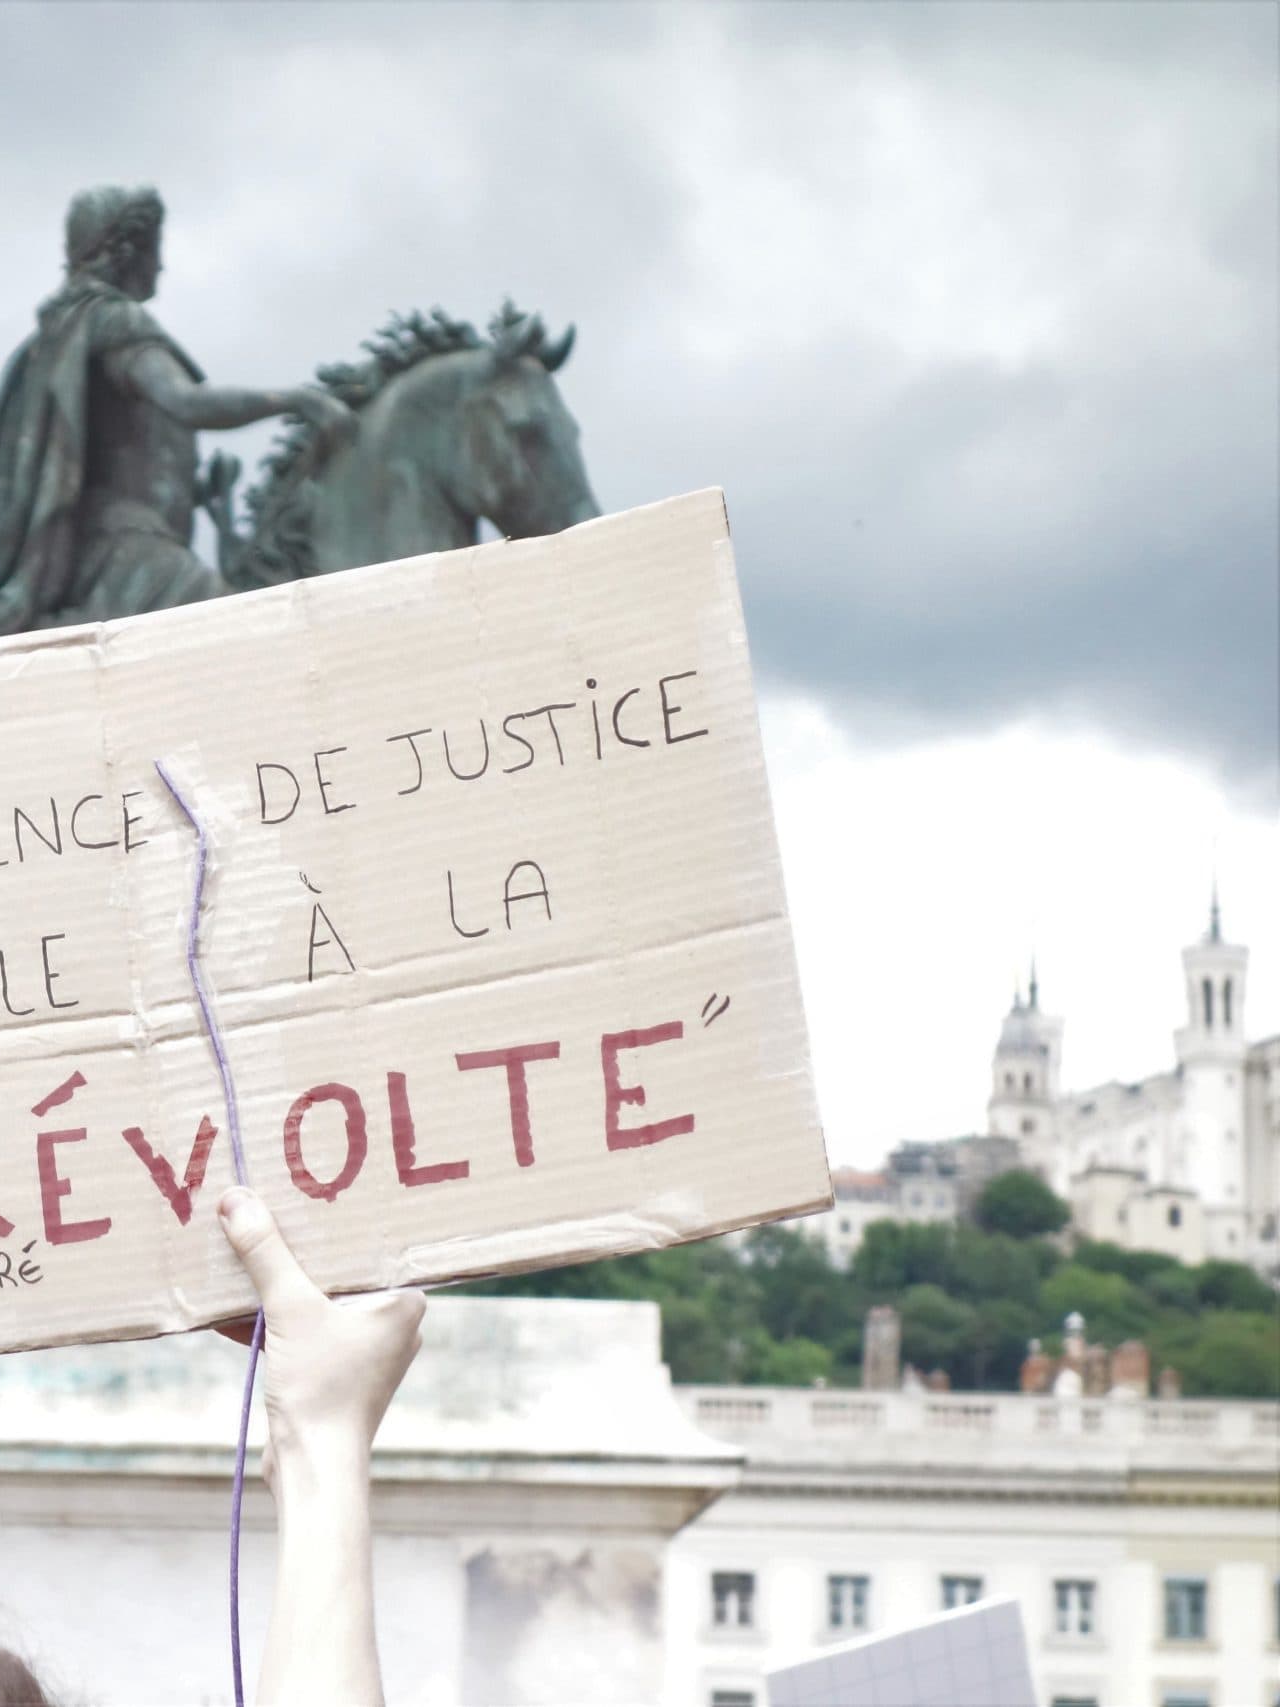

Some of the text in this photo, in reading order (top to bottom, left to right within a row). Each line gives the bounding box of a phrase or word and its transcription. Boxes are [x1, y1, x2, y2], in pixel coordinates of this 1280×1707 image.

[256, 746, 357, 825] DE
[299, 871, 357, 983] À
[448, 860, 552, 939] LA
